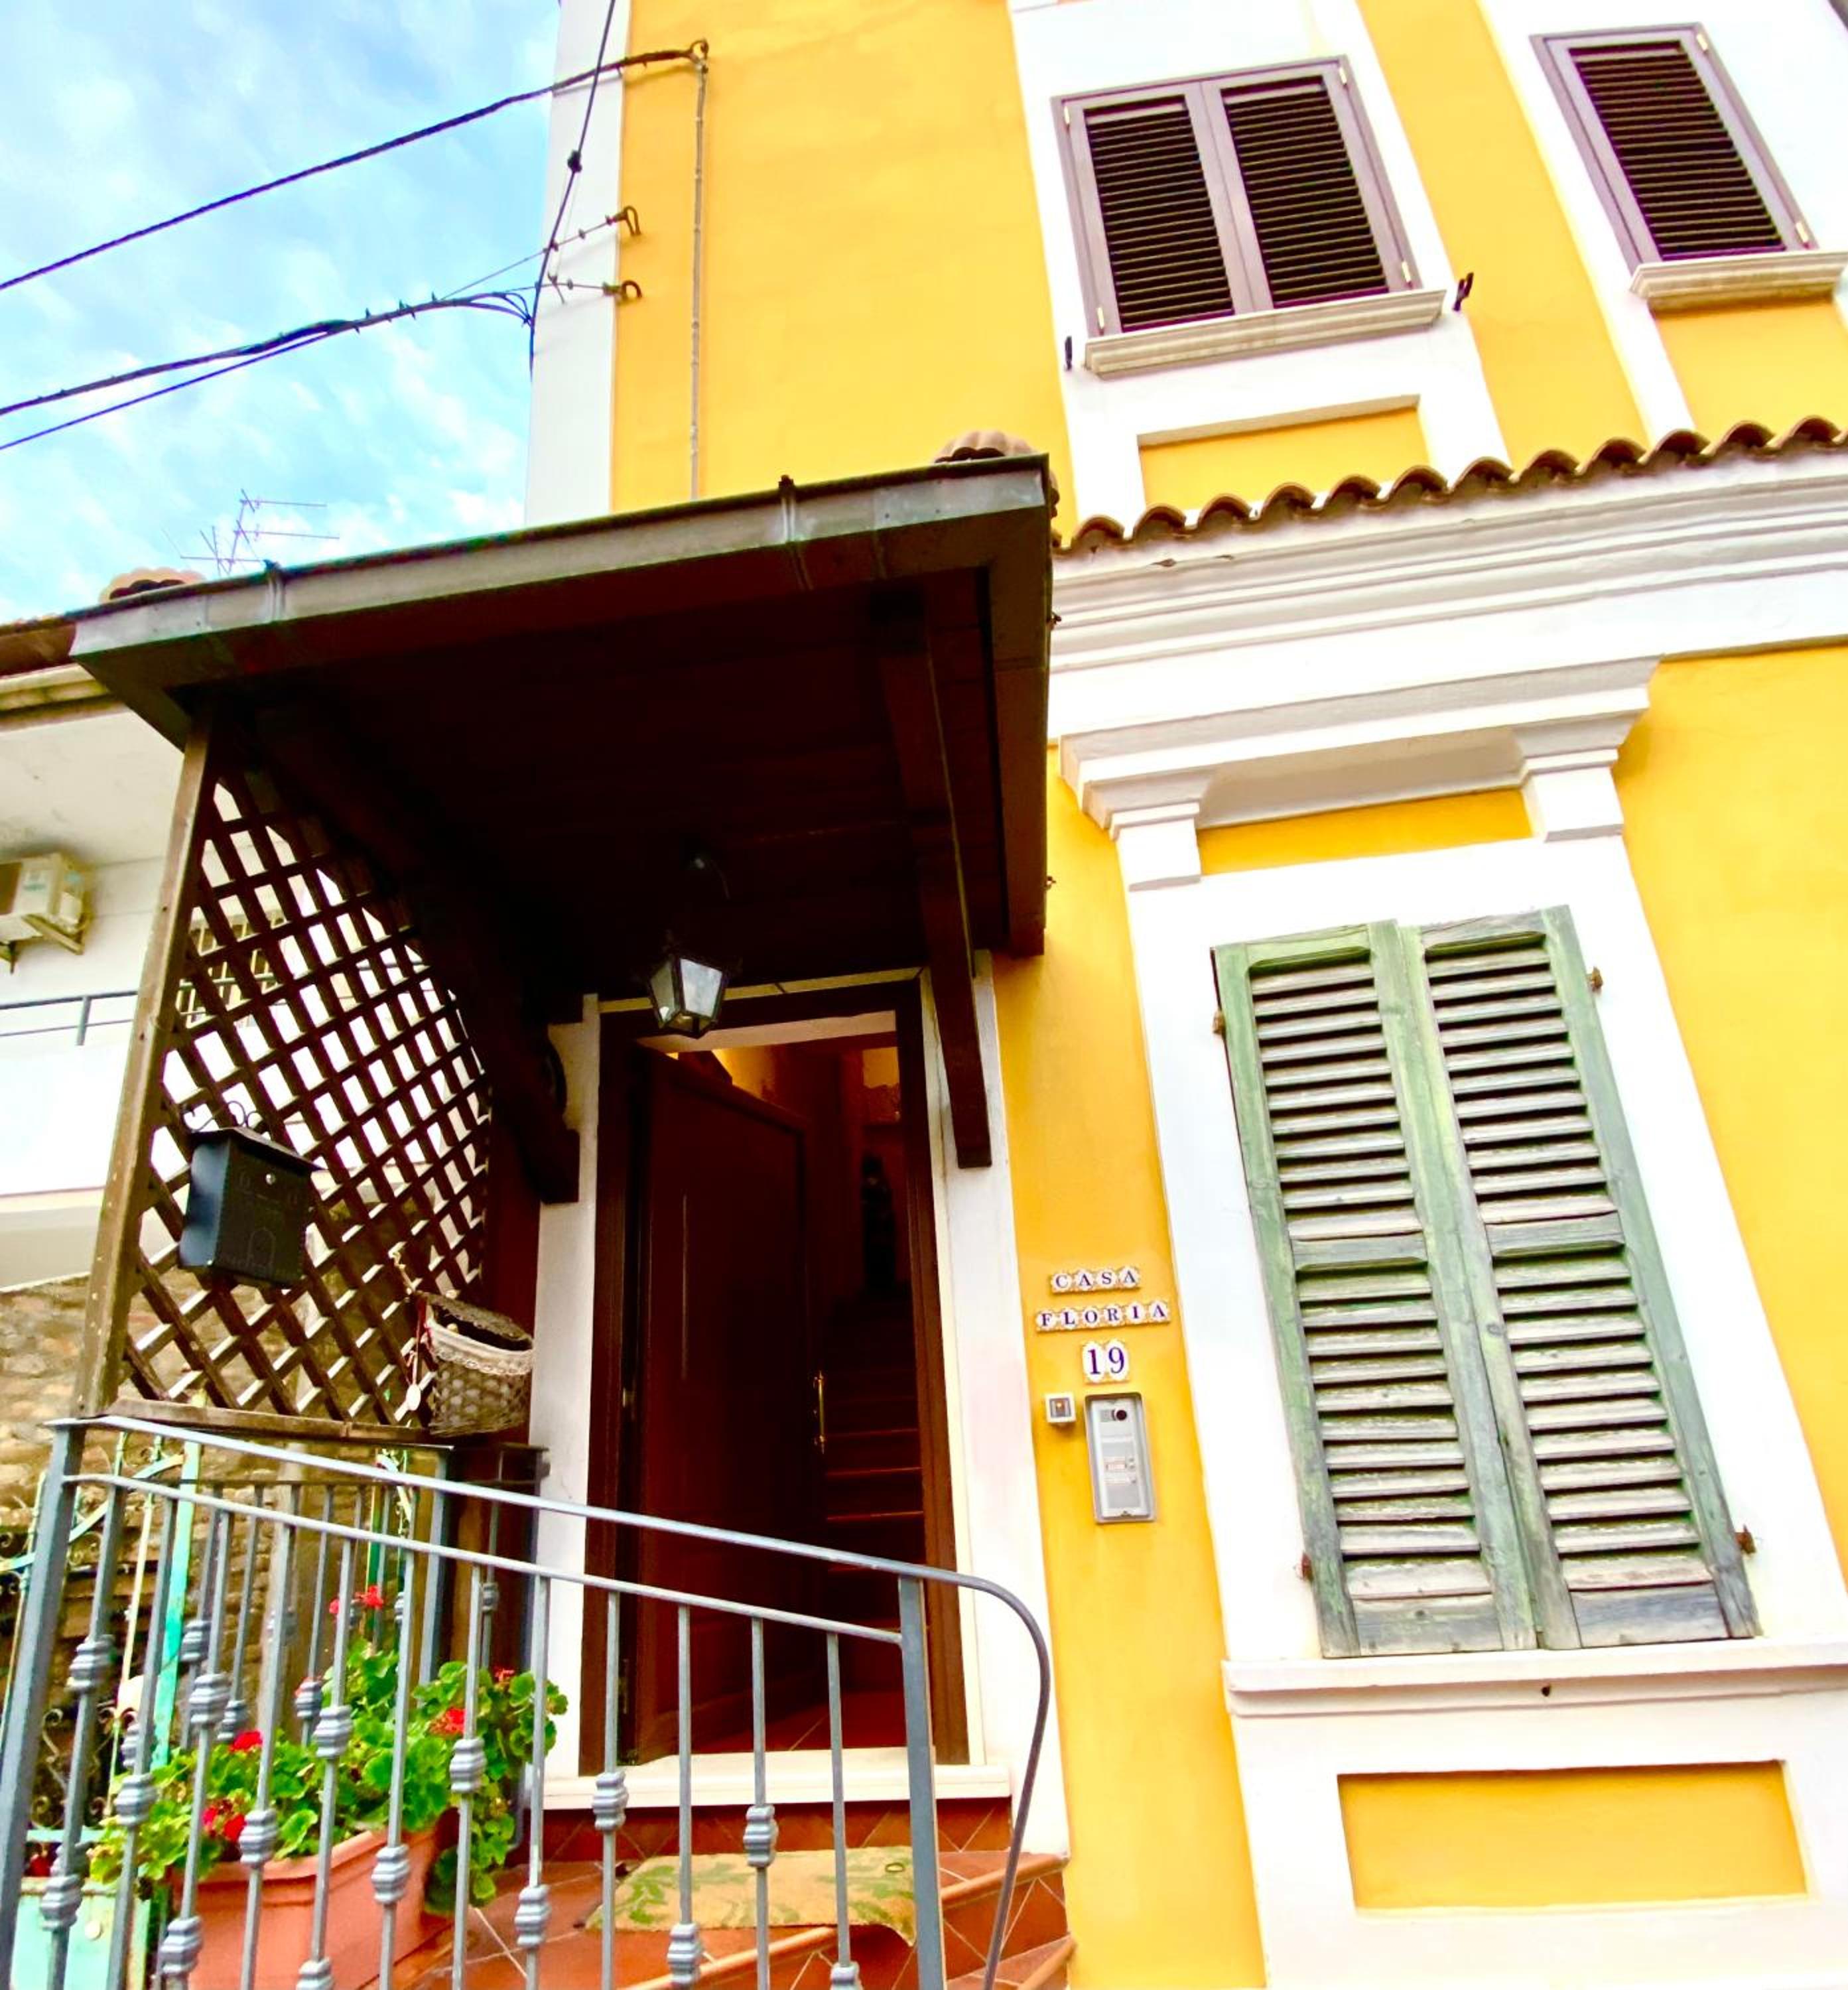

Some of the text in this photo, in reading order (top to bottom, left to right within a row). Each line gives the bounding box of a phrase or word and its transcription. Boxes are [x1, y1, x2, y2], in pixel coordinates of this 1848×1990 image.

[1055, 1270, 1136, 1288] CASA
[1041, 1304, 1165, 1327] FLORIA
[1087, 1347, 1125, 1375] 19
